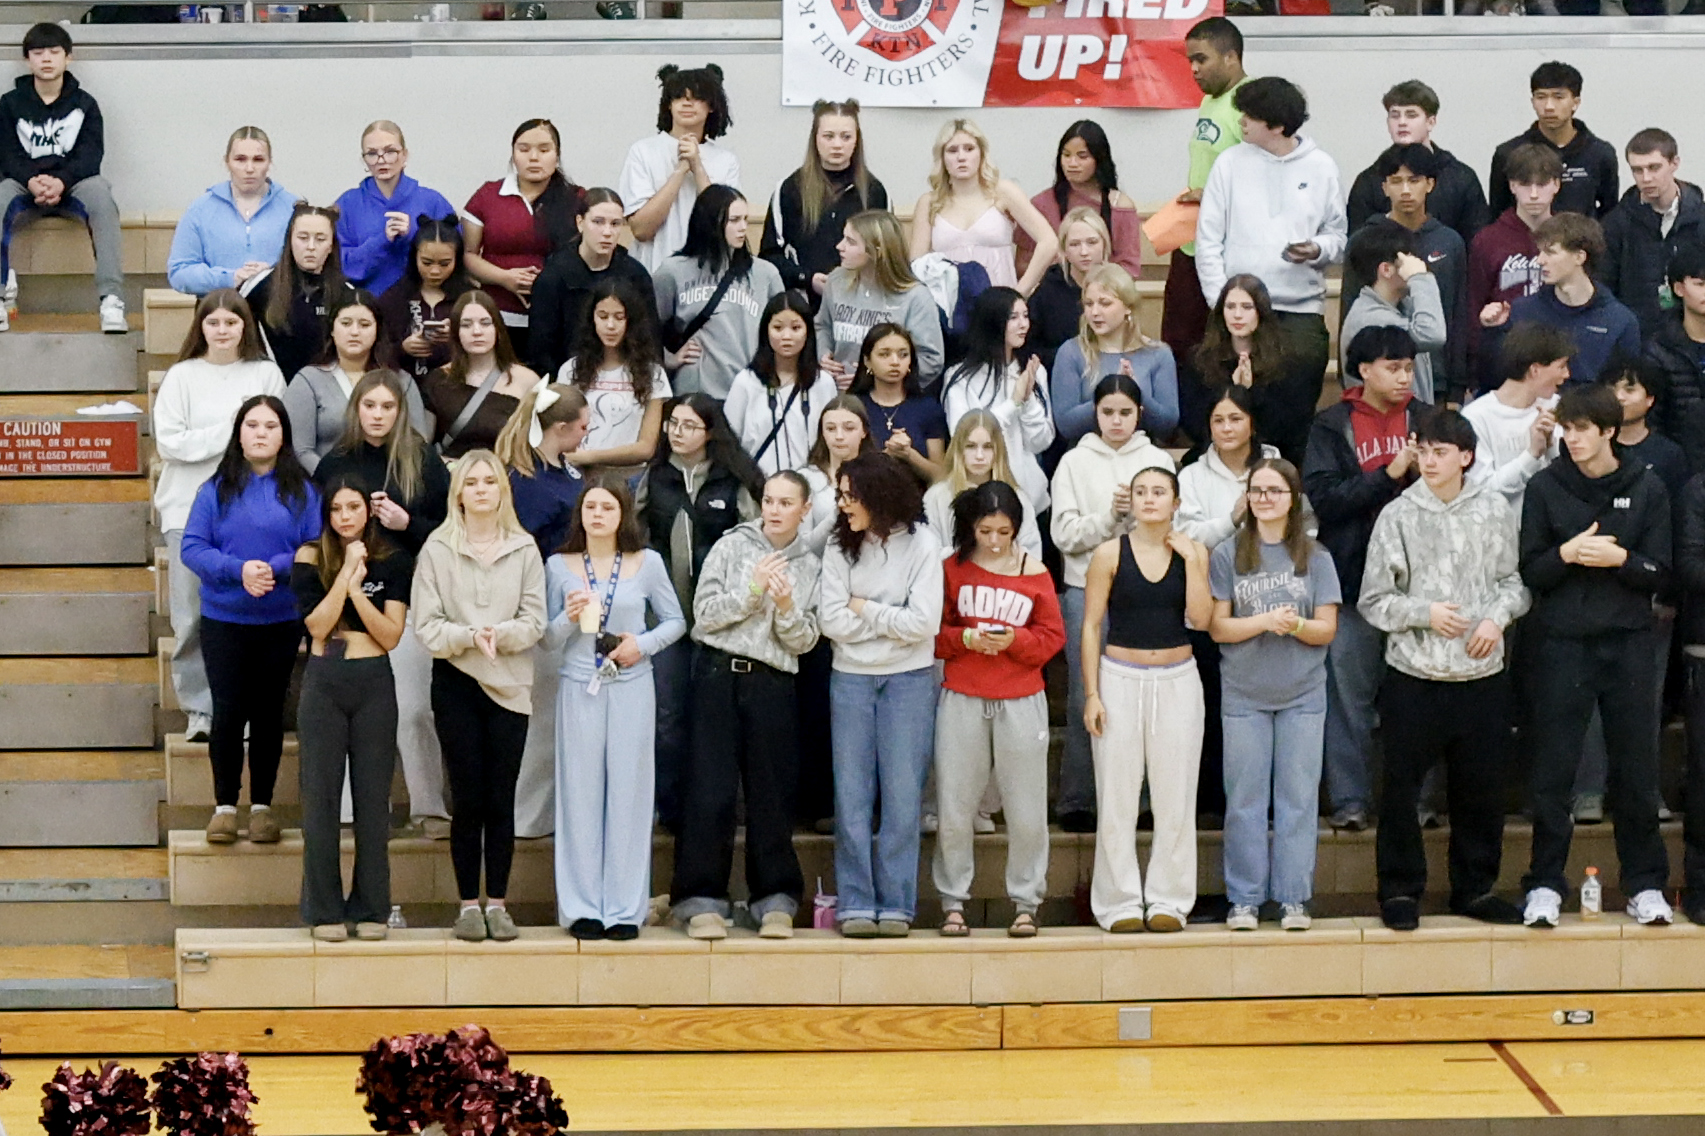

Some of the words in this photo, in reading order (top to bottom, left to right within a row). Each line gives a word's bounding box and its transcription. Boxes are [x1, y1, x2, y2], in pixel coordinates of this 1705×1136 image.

[866, 32, 921, 53] KTN
[811, 30, 860, 77] FIRE
[863, 33, 974, 87] FIGHTERS
[1017, 34, 1128, 81] UP!
[1501, 253, 1540, 273] Ketch
[4, 421, 61, 436] CAUTION
[16, 439, 44, 449] STAND,
[48, 438, 60, 448] OR
[63, 437, 75, 448] SIT
[79, 438, 91, 448] ON
[95, 438, 112, 448] GYM
[5, 451, 15, 460] IN
[18, 451, 33, 460] THE
[37, 451, 67, 460] CLOSED
[70, 450, 107, 460] POSITION
[23, 462, 37, 473] THE
[41, 462, 112, 473] UNDERSTRUCTURE
[957, 584, 1034, 627] ADHD
